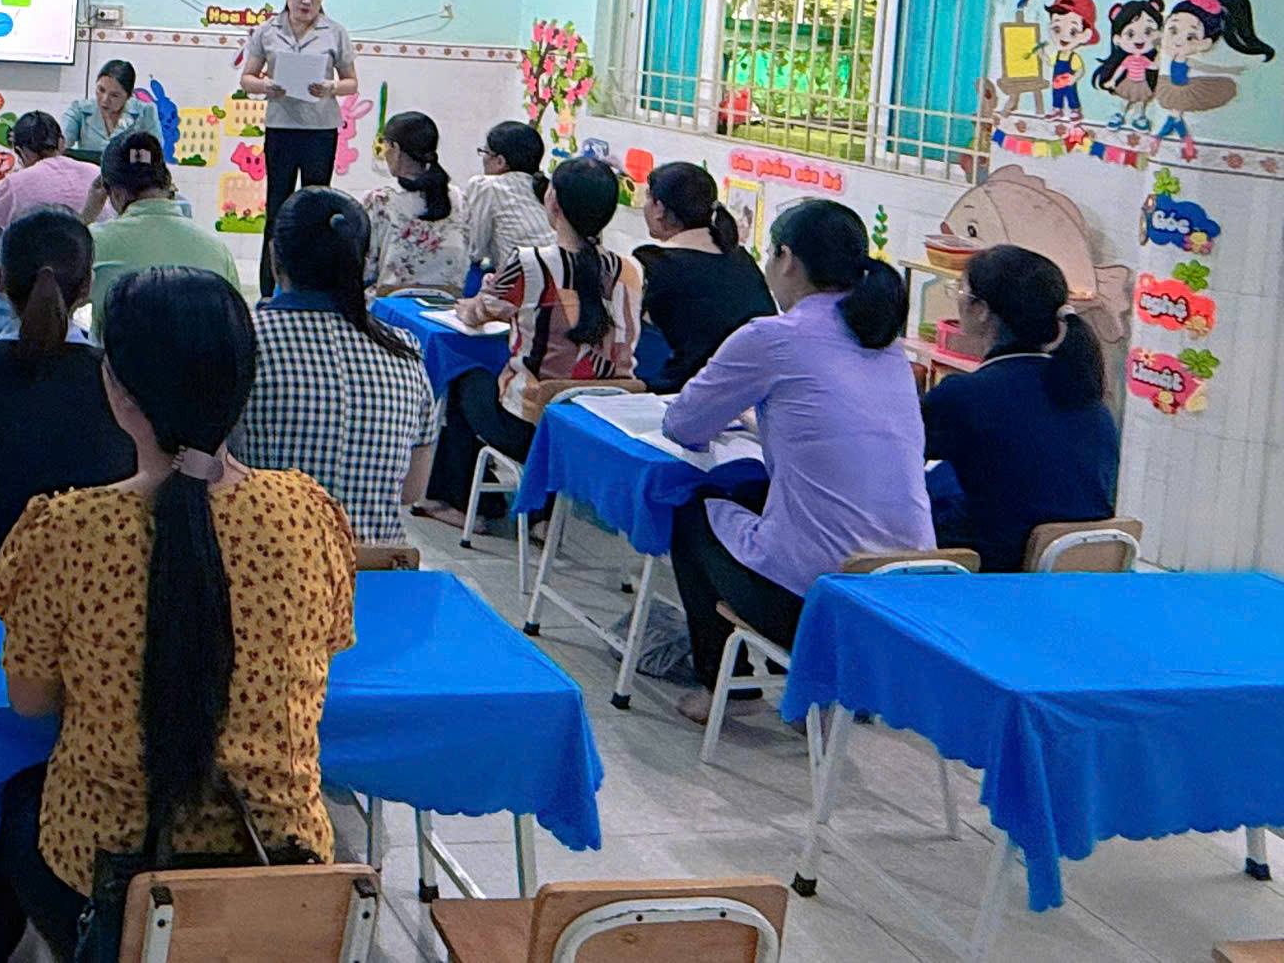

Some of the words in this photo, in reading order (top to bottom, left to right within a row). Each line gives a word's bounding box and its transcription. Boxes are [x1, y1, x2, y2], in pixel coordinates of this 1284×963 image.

[207, 6, 241, 25] Hoa
[1151, 209, 1191, 234] Góc
[1139, 291, 1189, 325] nghệ
